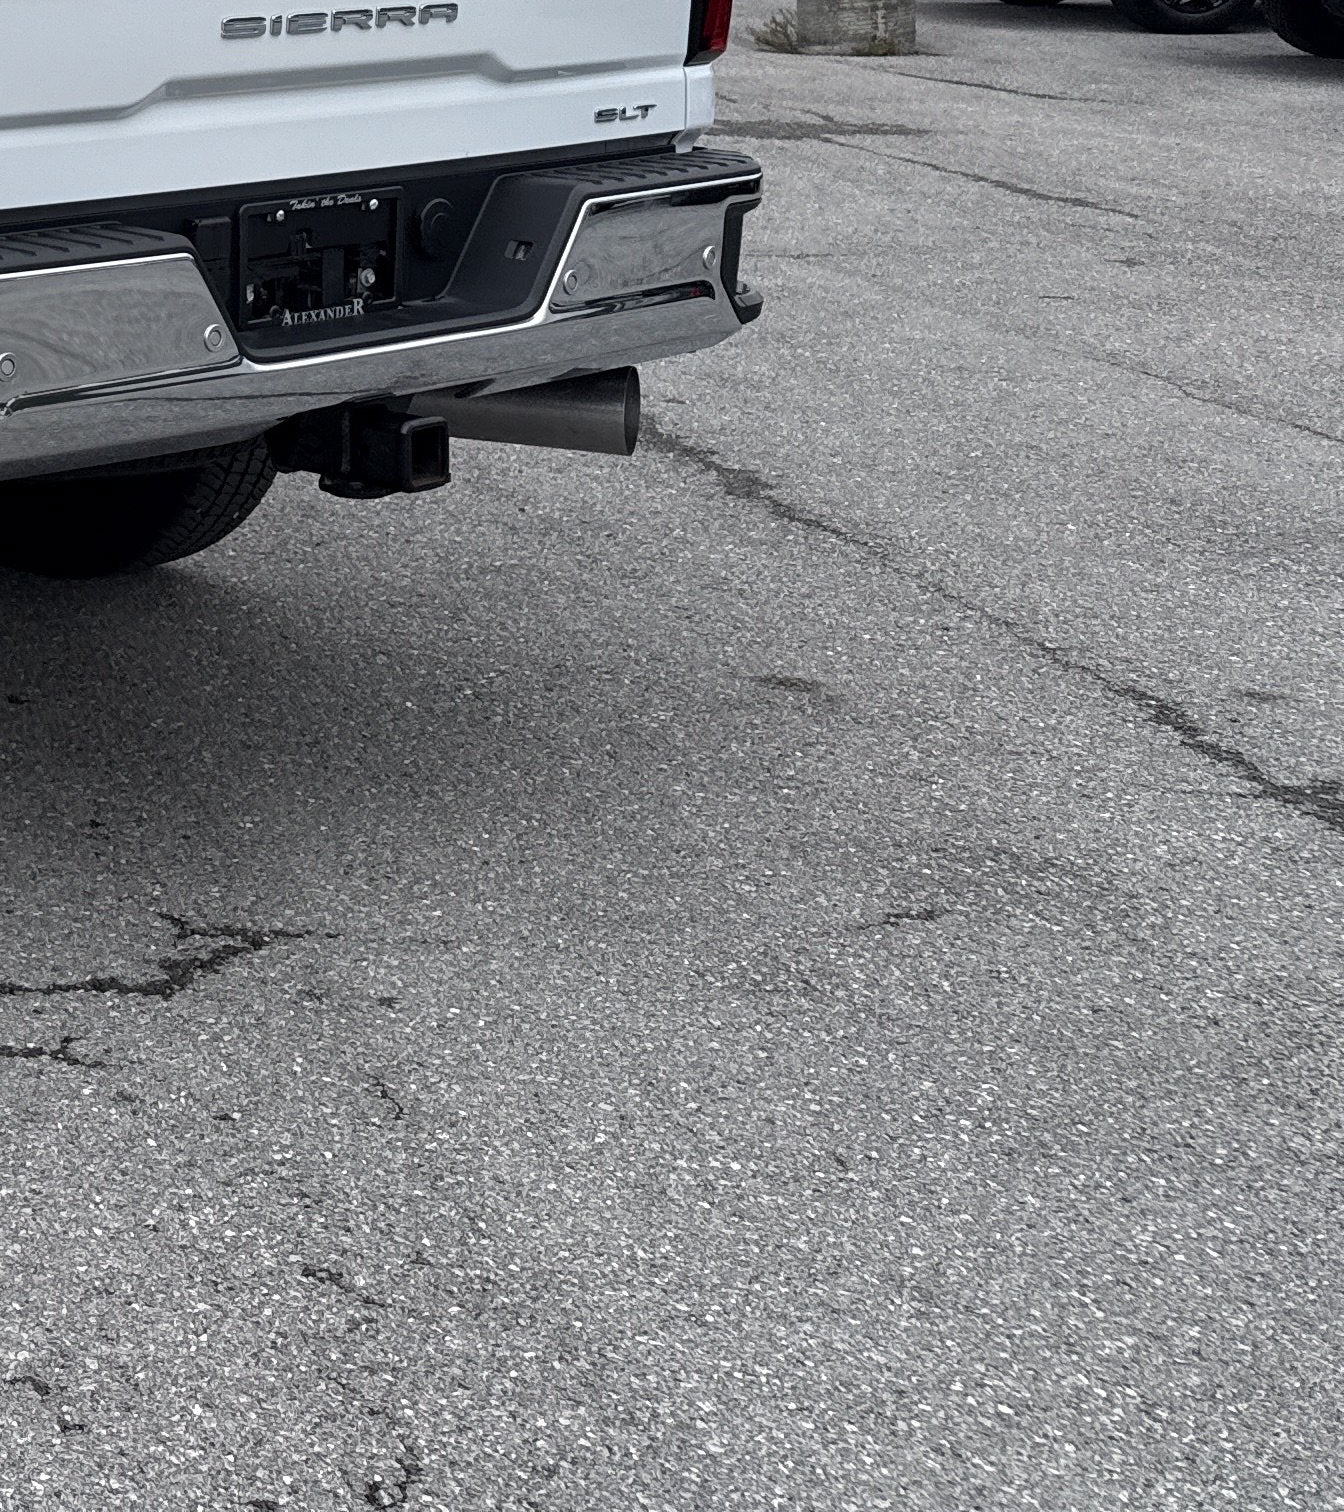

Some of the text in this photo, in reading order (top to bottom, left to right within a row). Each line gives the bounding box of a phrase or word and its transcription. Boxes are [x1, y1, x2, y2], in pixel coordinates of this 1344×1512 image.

[220, 2, 459, 39] SIERRA
[594, 104, 658, 123] SLT
[281, 298, 366, 327] ALEXANDER
